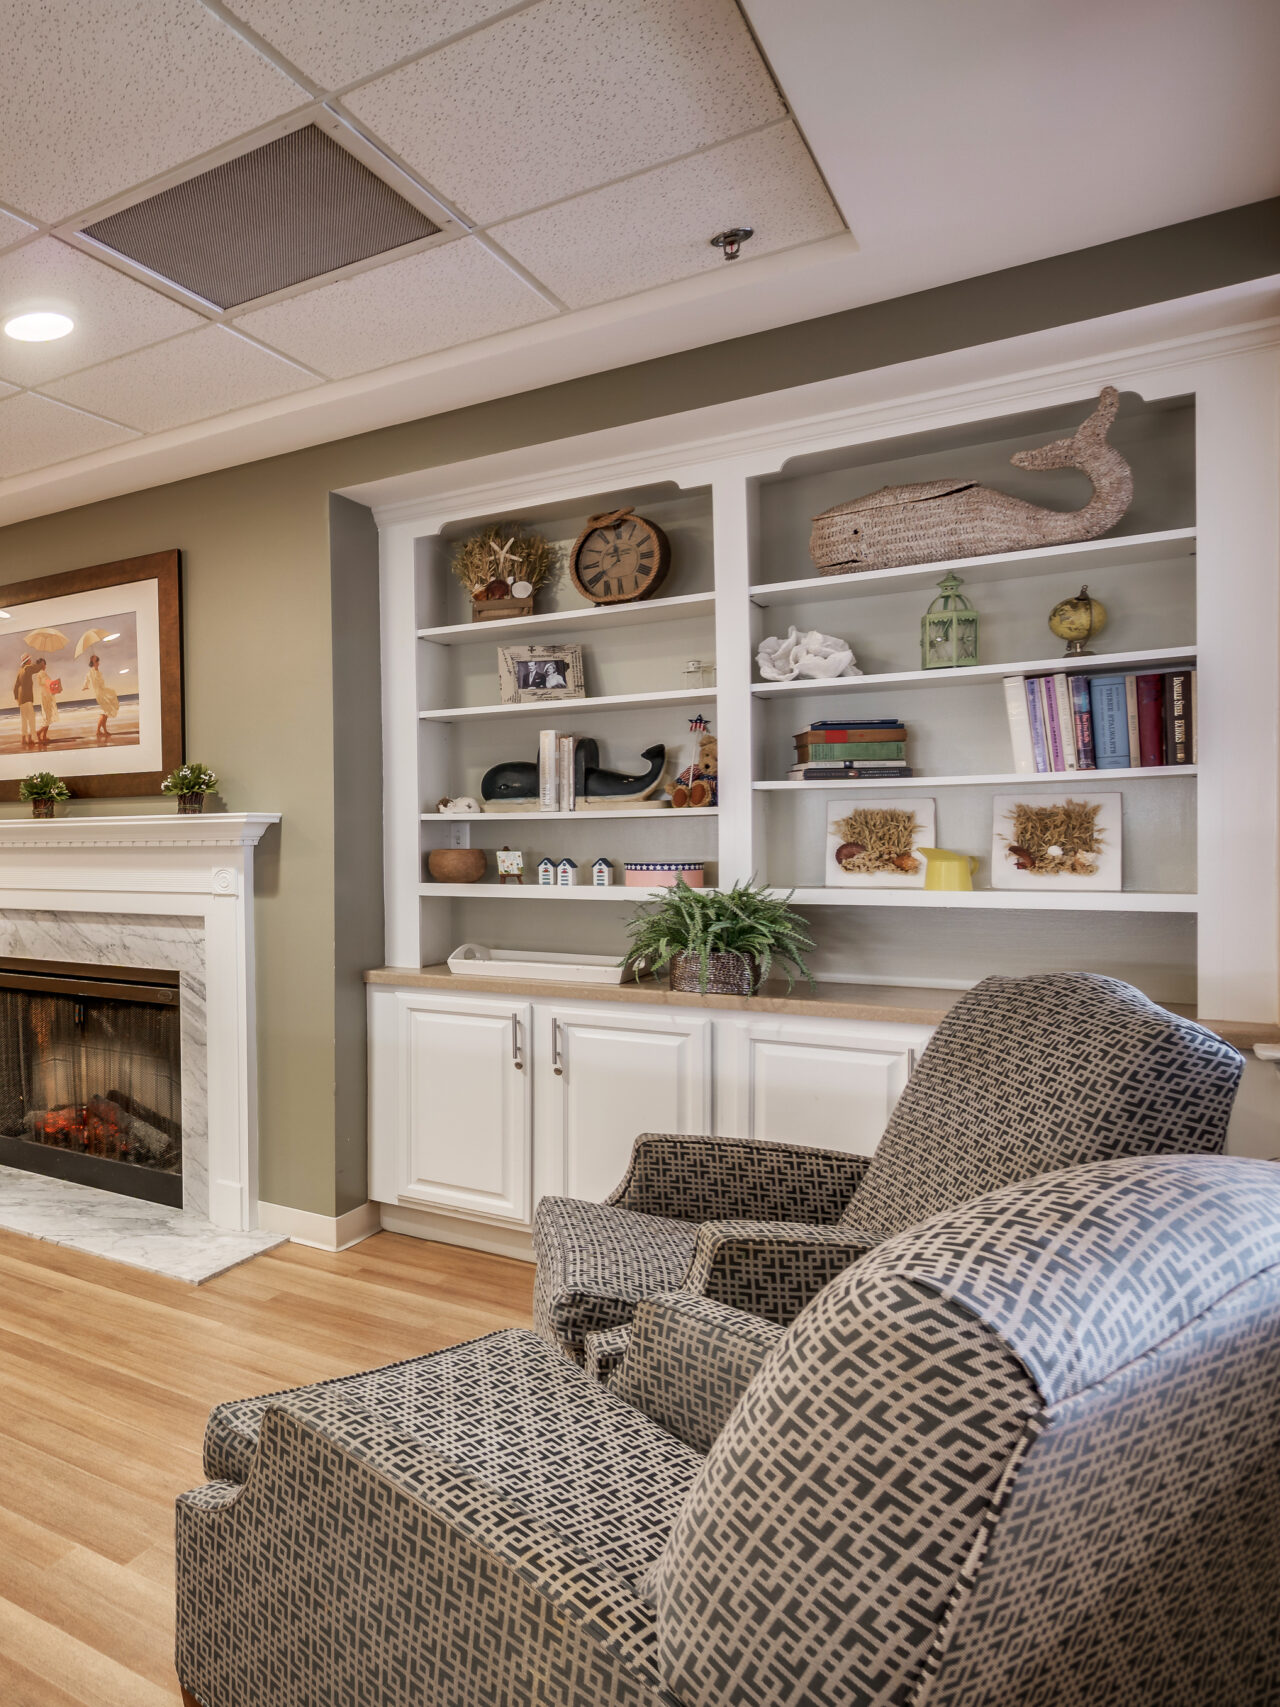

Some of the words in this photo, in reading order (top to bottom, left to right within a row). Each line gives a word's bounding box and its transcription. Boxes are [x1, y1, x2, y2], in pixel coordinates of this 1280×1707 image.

[1174, 677, 1185, 700] DANIELLE
[1173, 700, 1185, 717] STEEL
[1174, 719, 1186, 743] ECHOES
